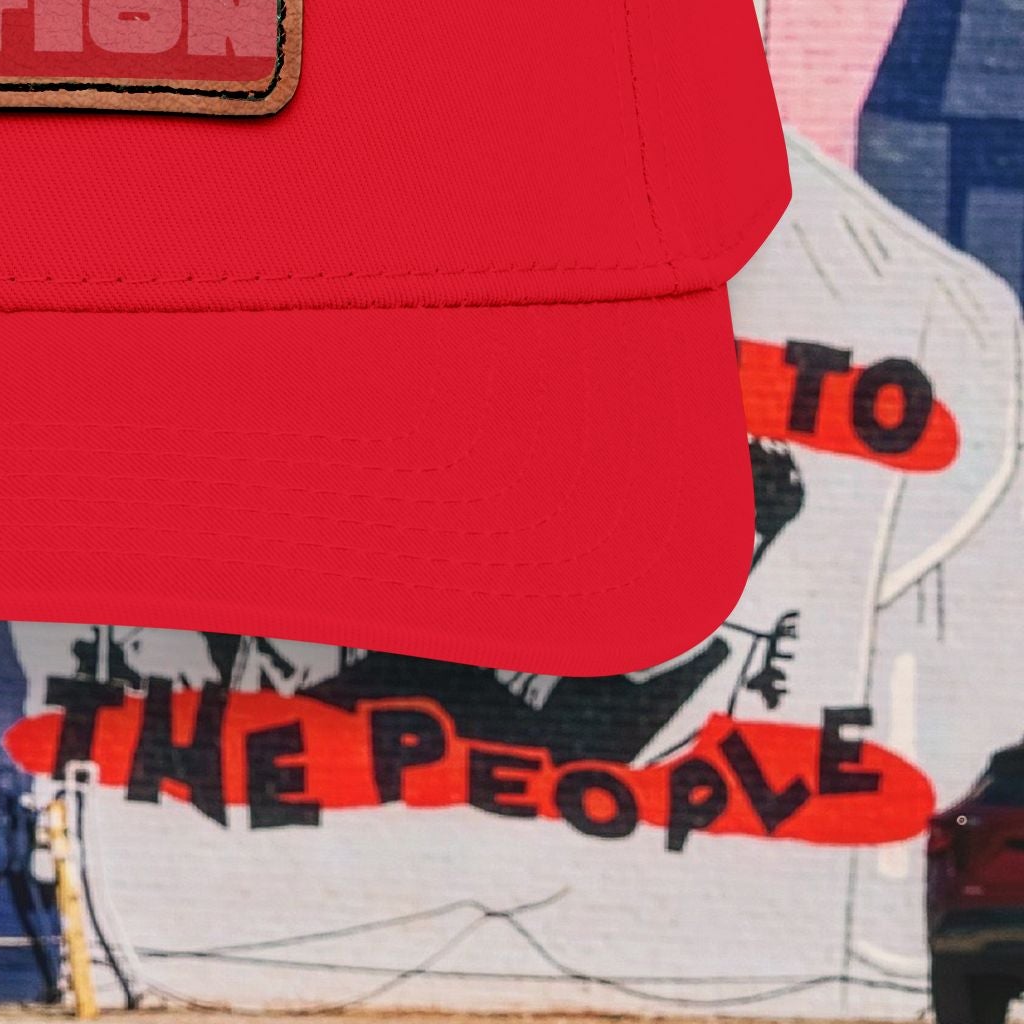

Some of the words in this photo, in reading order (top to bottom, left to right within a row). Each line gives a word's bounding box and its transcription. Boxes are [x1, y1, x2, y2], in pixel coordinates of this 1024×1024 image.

[785, 339, 933, 455] TO
[46, 676, 320, 829] THE
[370, 706, 882, 853] PEOPLE
